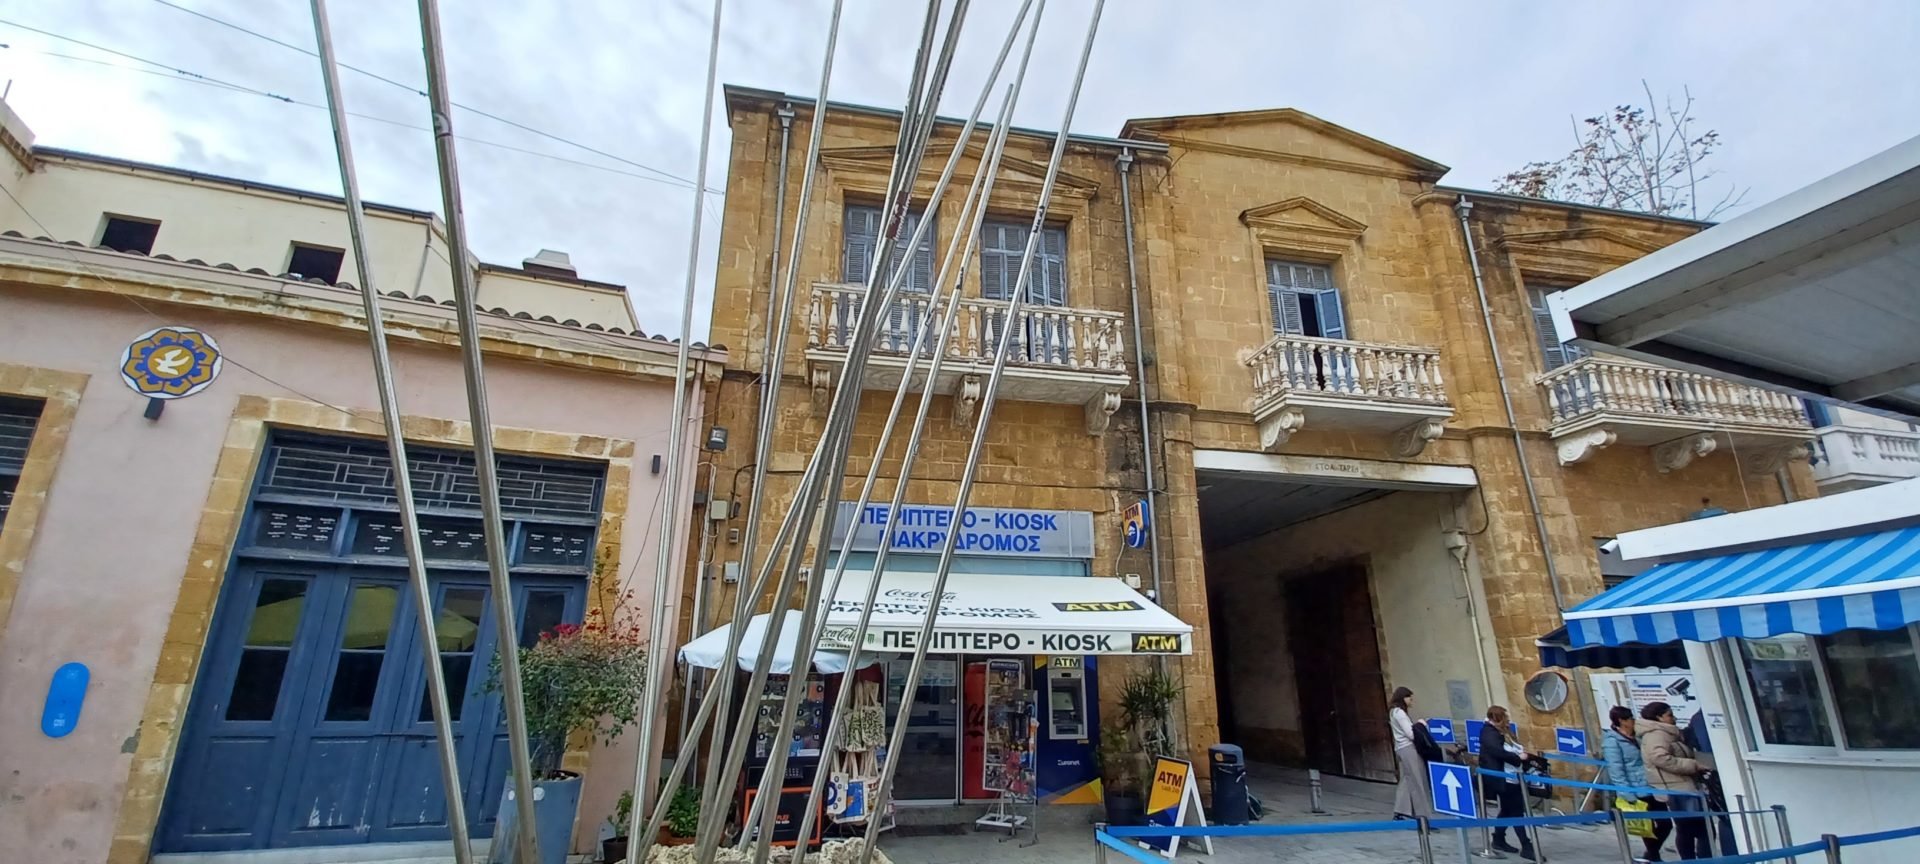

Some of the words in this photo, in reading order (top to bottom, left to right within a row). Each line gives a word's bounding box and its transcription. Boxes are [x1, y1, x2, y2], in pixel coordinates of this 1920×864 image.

[860, 507, 977, 528] ΠΕΙΠΤΕΟ
[995, 512, 1058, 531] KIOSK
[1124, 503, 1140, 521] ATM
[821, 599, 949, 611] ΕΡΠΤΕΡΟ
[829, 606, 1041, 618] ΜΑΚΡΥΡΟΜΟΣ
[1066, 601, 1135, 611] ATM
[883, 630, 1021, 651] ΠΕΙΠΤΕΡΟ
[1042, 634, 1113, 651] KIOSK
[1136, 635, 1178, 650] ATM
[1053, 657, 1081, 668] ATM
[1158, 770, 1182, 788] ATM
